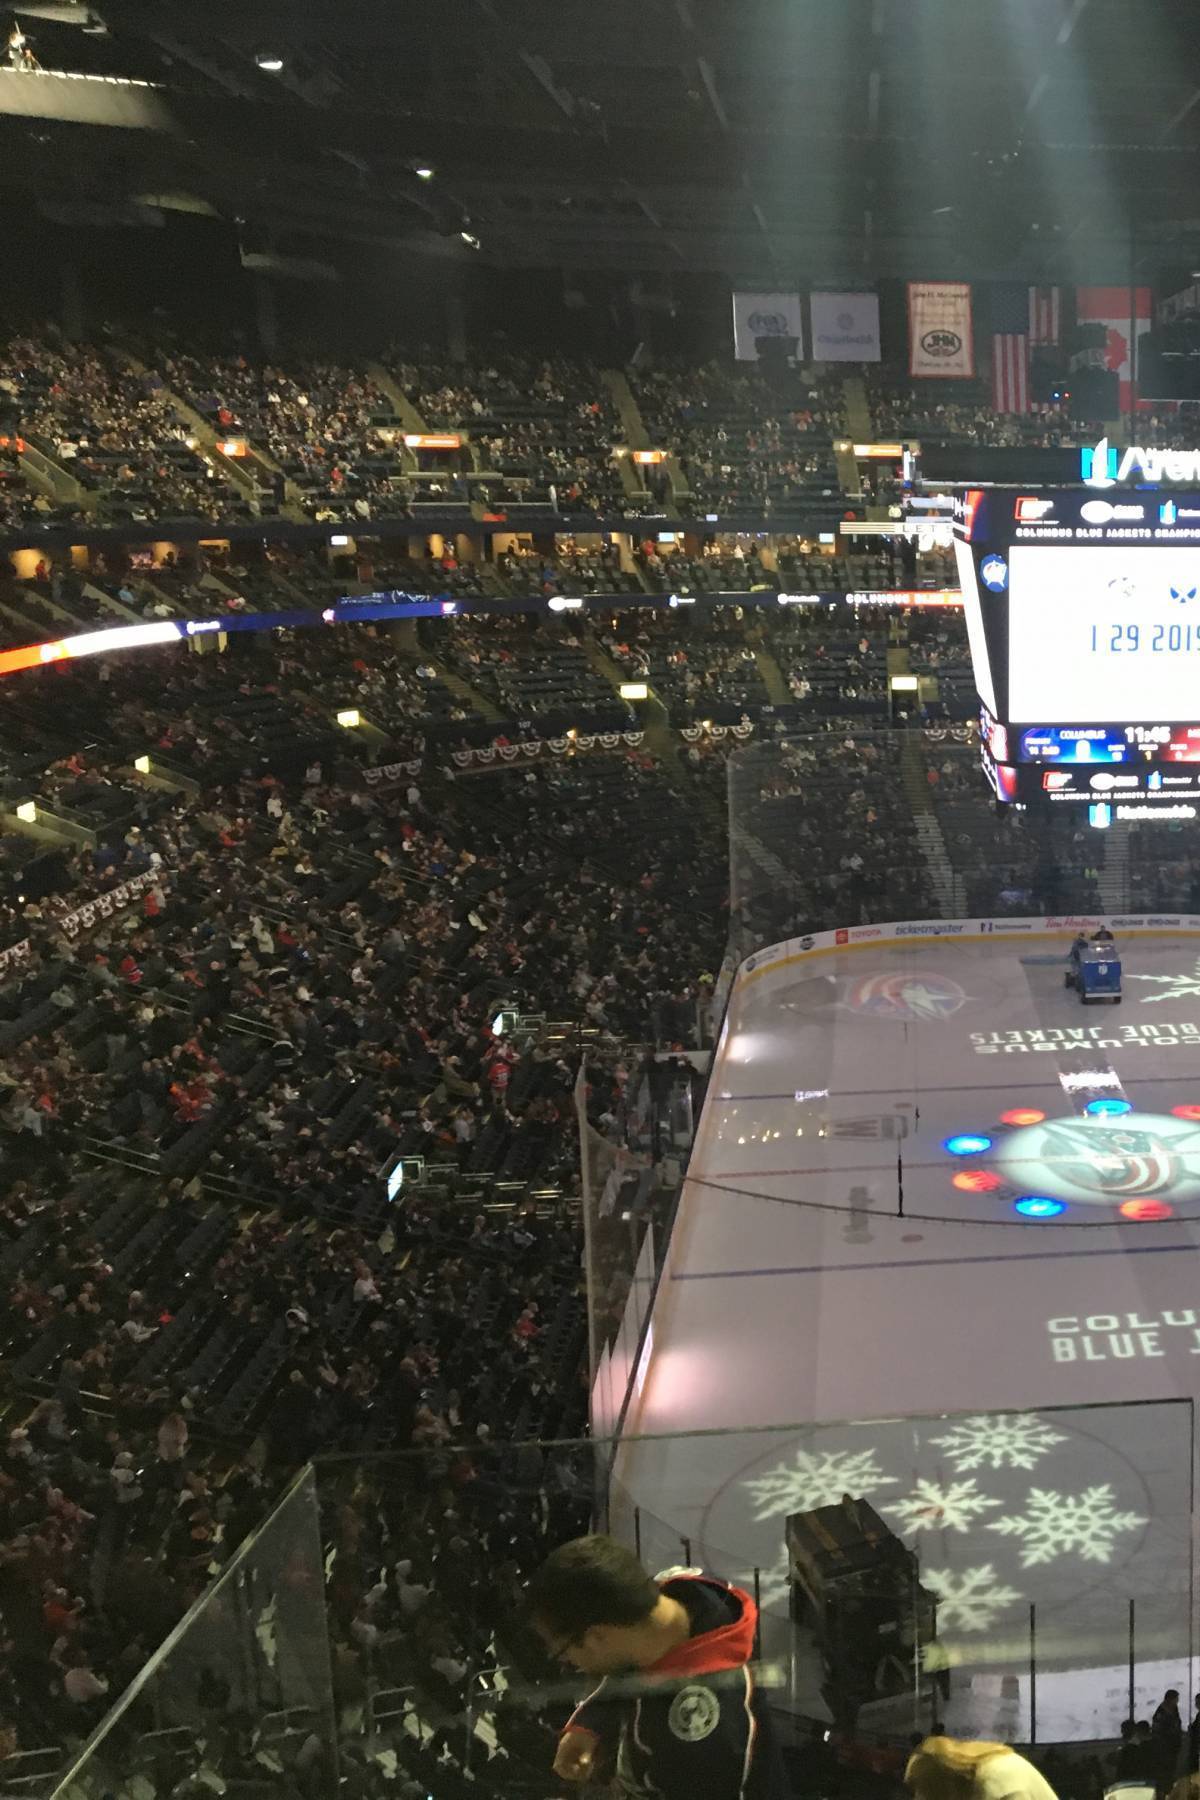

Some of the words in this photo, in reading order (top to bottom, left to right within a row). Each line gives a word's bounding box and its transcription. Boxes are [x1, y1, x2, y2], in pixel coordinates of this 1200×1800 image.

[1015, 527, 1073, 538] COLUMBUS
[1075, 527, 1103, 538] BLUE
[1106, 527, 1151, 538] JACKETS
[1110, 624, 1140, 652] 29
[1060, 729, 1106, 740] COLUMBUS
[850, 928, 882, 938] TOYOTA
[895, 924, 964, 936] ticketmaster
[969, 1026, 1103, 1046] JACKETS
[1119, 1022, 1200, 1038] BLUE
[1052, 1331, 1166, 1363] BLUE
